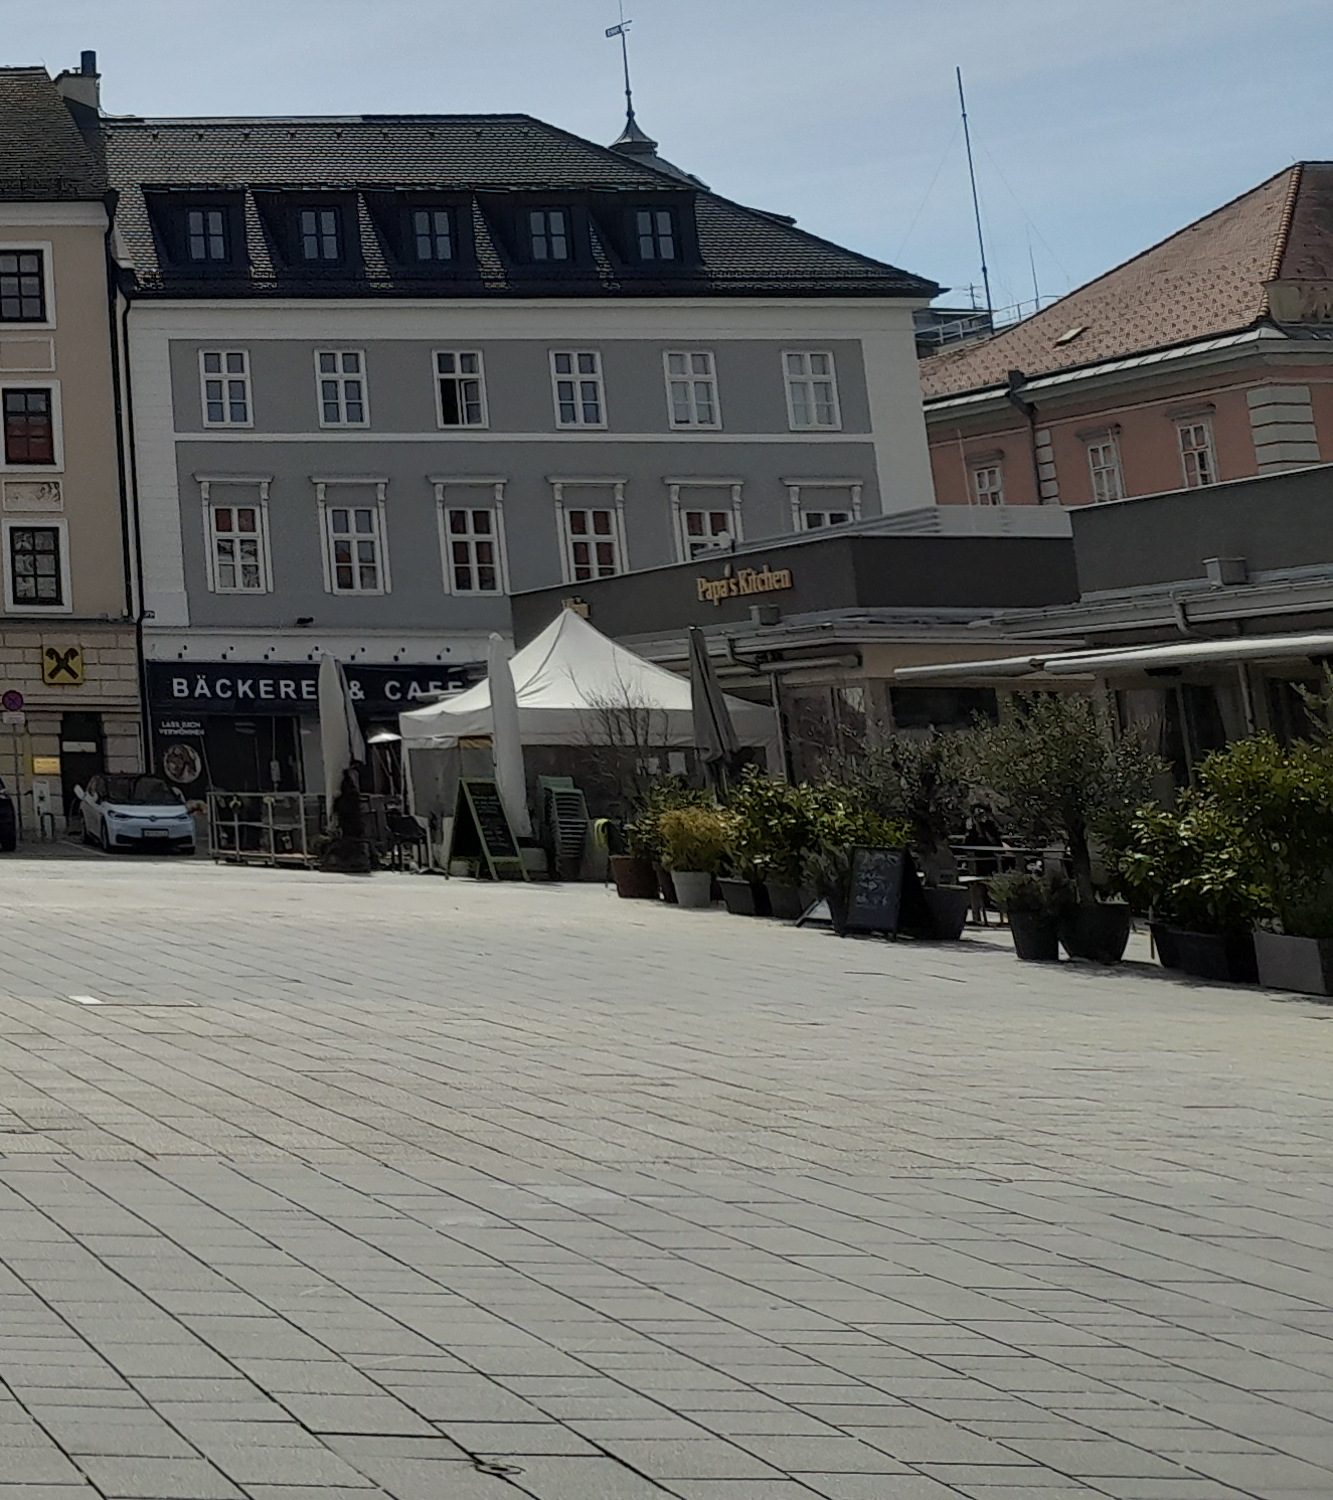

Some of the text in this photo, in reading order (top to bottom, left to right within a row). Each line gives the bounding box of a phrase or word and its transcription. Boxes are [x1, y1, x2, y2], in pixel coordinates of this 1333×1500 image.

[696, 564, 792, 606] Papa's Kitchen
[171, 674, 318, 699] BÄCKERE
[349, 680, 366, 700] &
